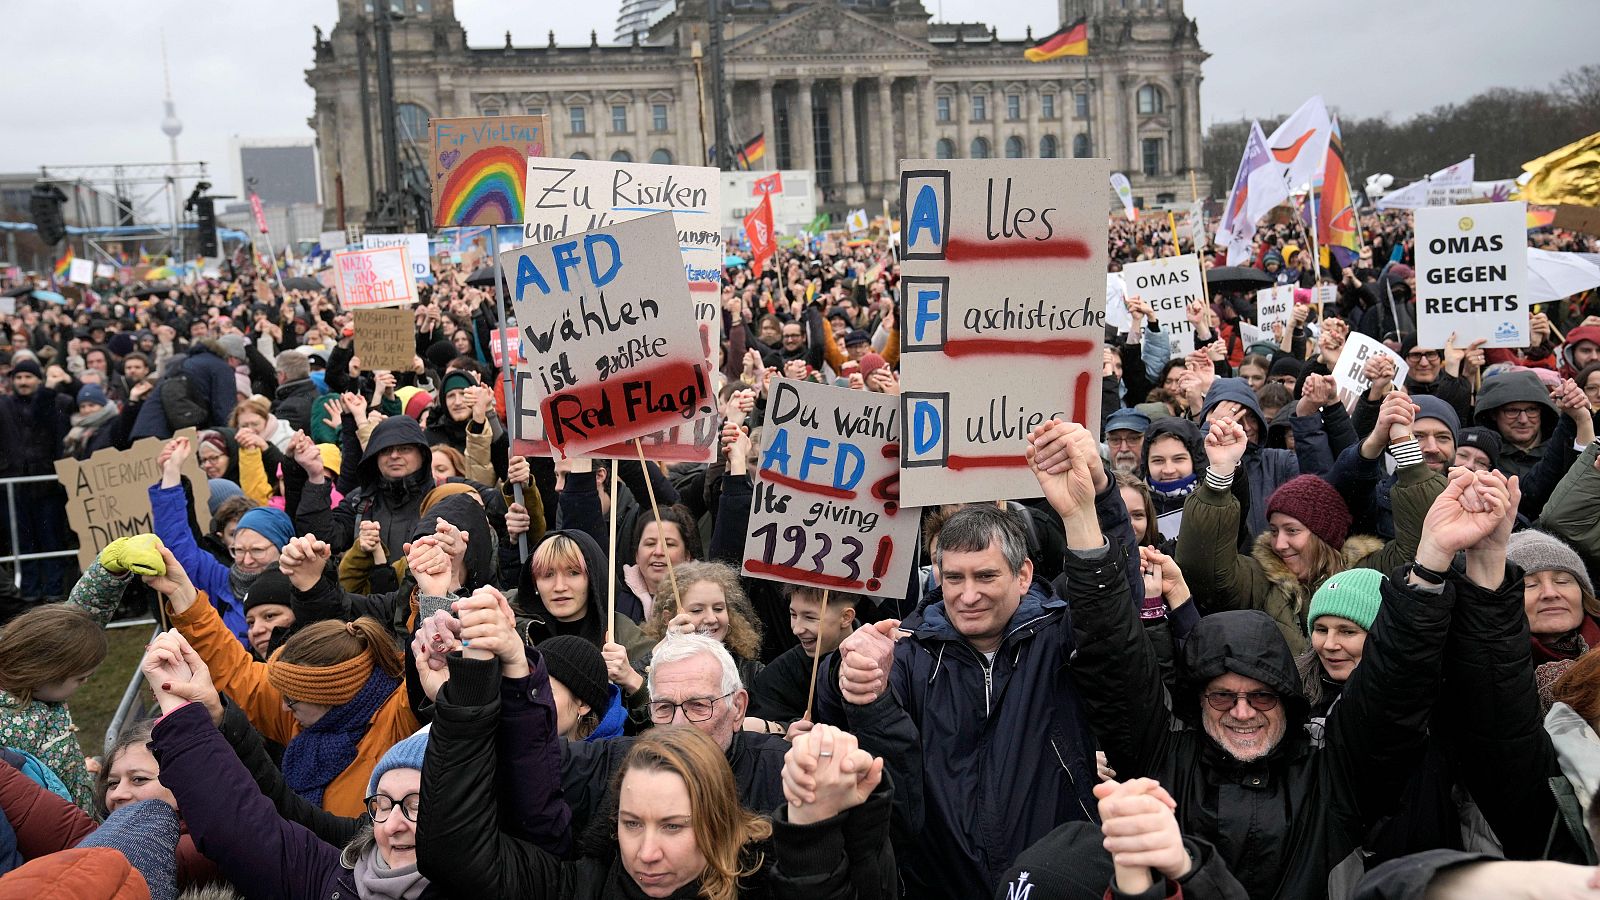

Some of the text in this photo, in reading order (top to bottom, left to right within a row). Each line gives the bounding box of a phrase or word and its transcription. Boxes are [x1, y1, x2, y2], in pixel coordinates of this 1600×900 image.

[532, 166, 707, 208] Zu Risiken
[1428, 234, 1504, 255] OMAS
[342, 255, 373, 273] NAZIS
[516, 233, 624, 302] AFD
[1136, 269, 1190, 289] OMAS
[1426, 265, 1507, 285] GEGEN
[350, 280, 396, 303] HARAM
[1144, 294, 1196, 312] EGEN
[1425, 295, 1519, 314] RECHTS
[524, 291, 659, 354] wählen
[1261, 303, 1286, 315] OMAS
[539, 352, 578, 394] ist
[594, 335, 669, 382] größte
[550, 388, 615, 445] Red
[771, 382, 819, 430] Du
[76, 457, 163, 497] ALTERNATI
[83, 494, 122, 524] FÜR
[803, 501, 879, 533] giving
[88, 512, 154, 555] DUMM
